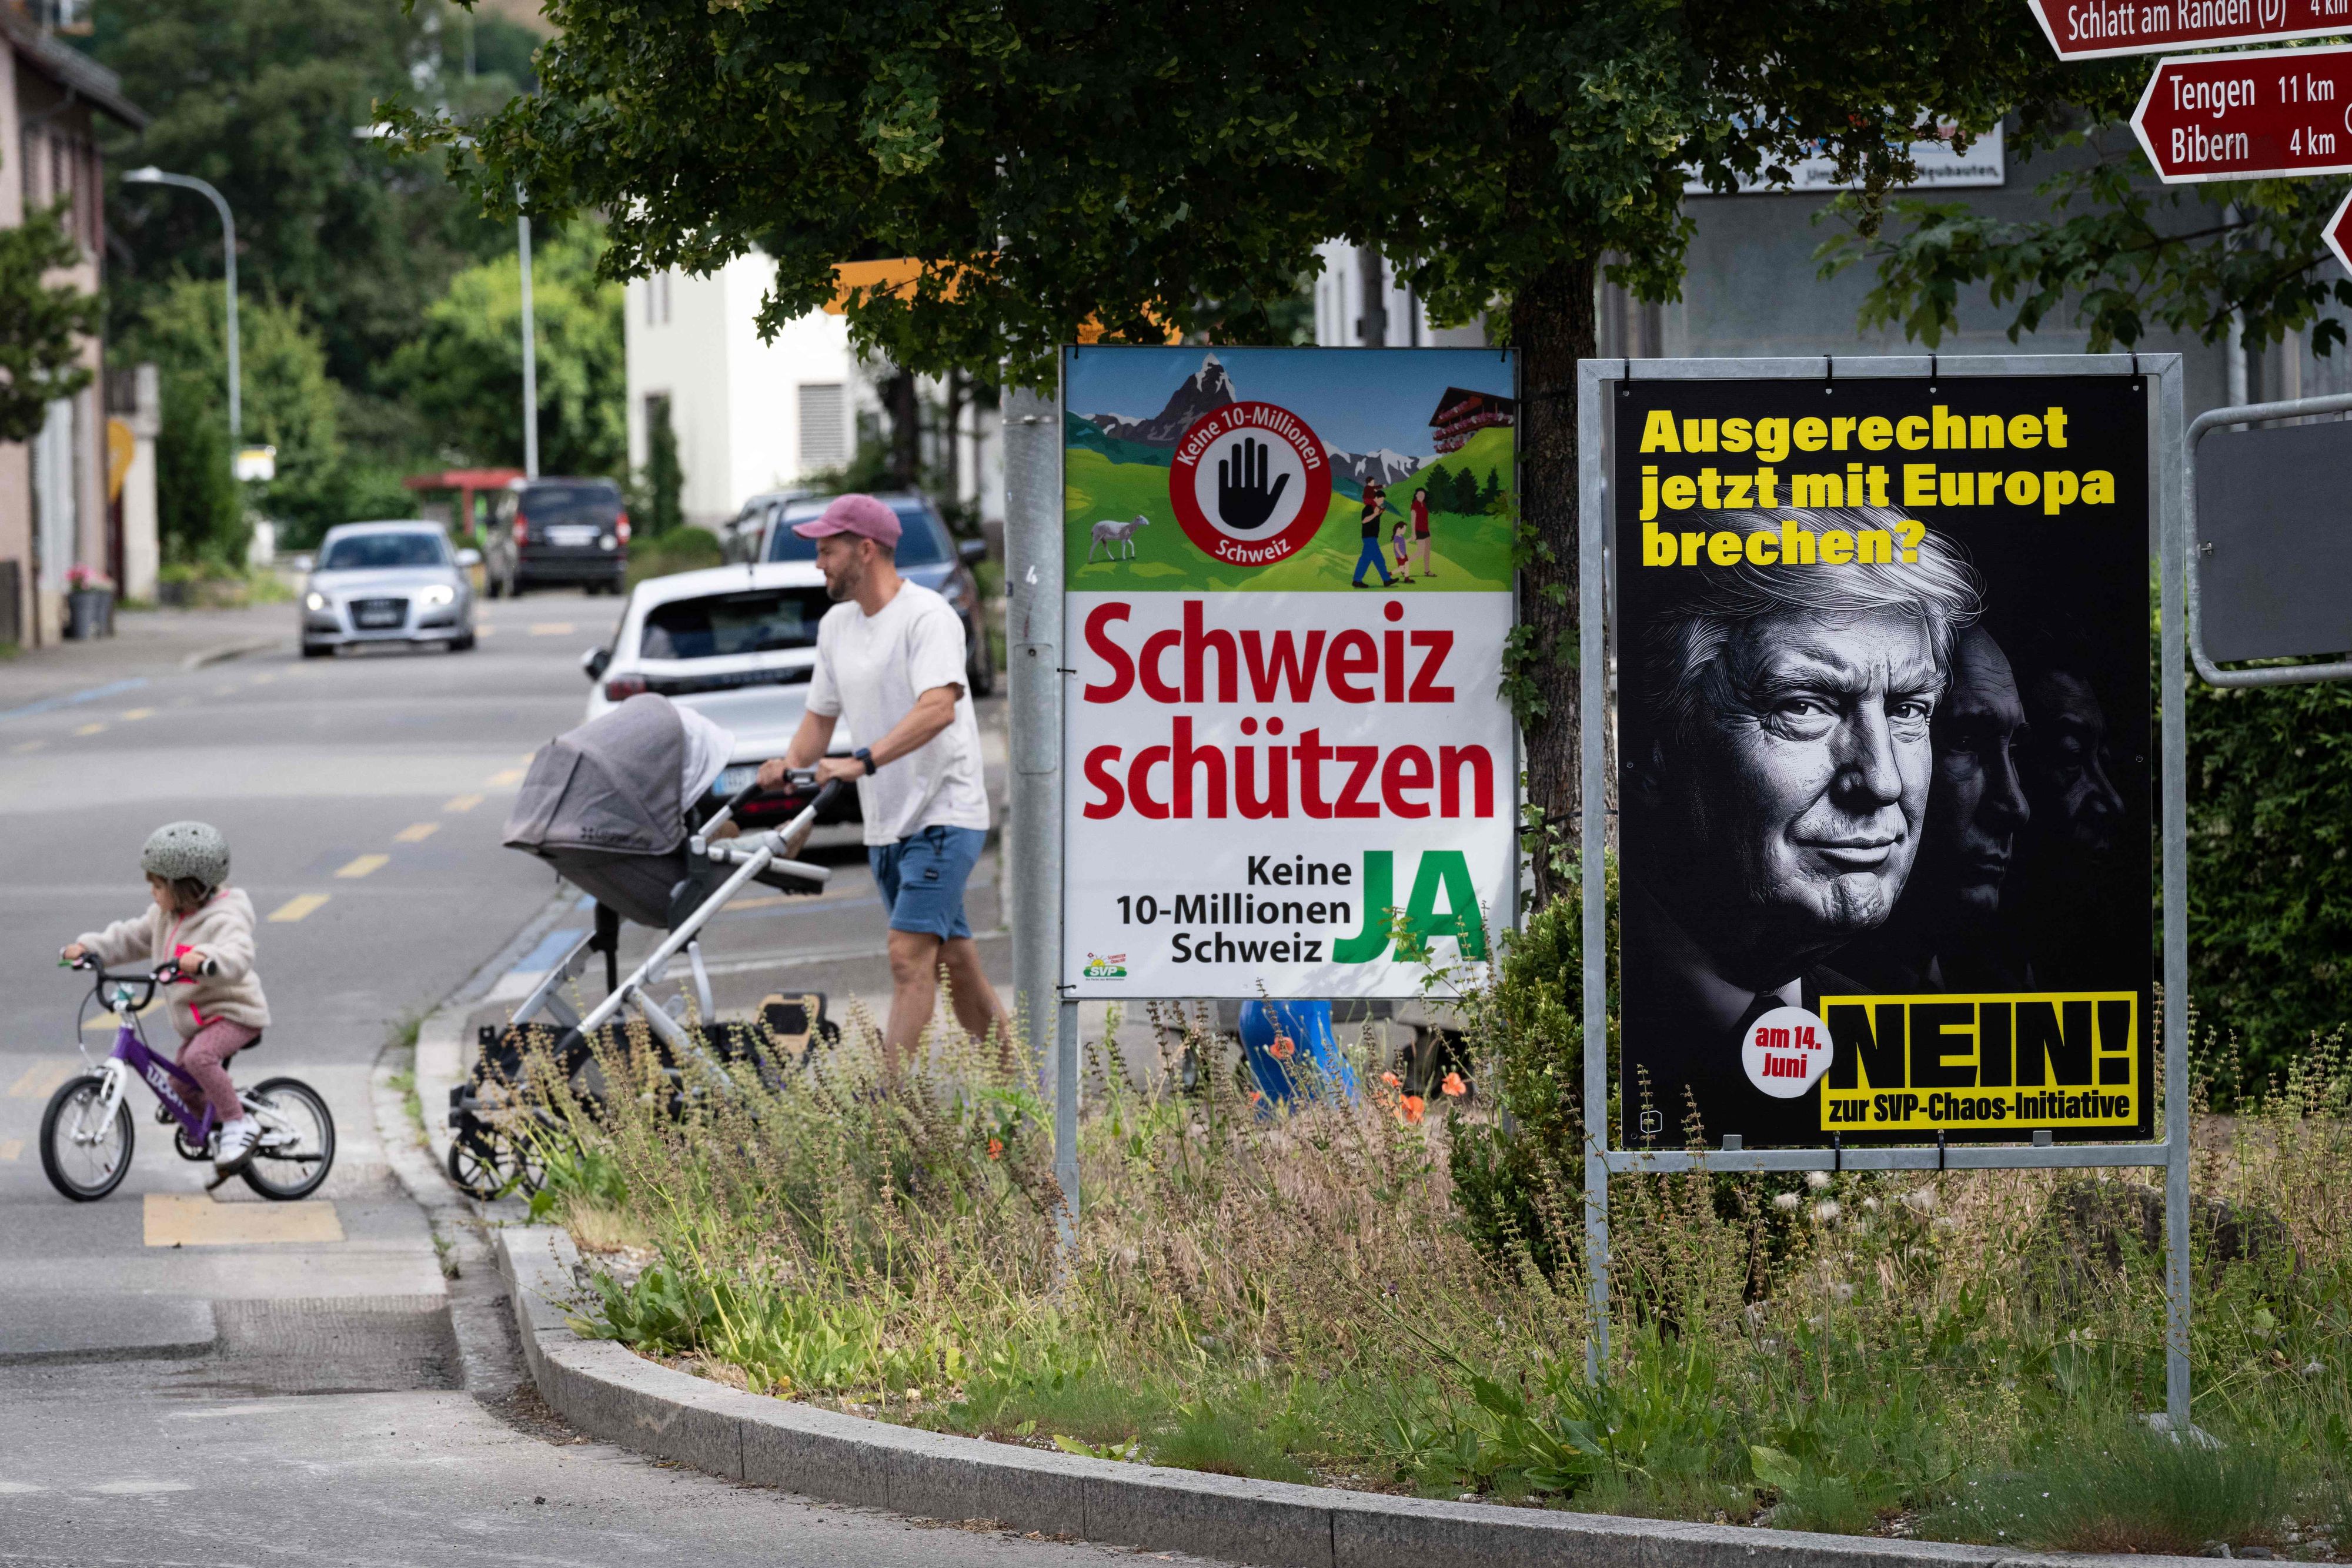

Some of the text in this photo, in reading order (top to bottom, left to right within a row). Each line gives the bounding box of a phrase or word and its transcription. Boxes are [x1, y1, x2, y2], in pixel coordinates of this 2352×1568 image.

[2068, 0, 2135, 40] Schlatt
[2141, 5, 2170, 34] am
[2178, 0, 2250, 29] Randen
[2258, 0, 2286, 29] (D)
[2170, 72, 2334, 118] Tengen 11 km
[2171, 124, 2336, 163] Bibern 4 km
[1177, 406, 1321, 470] Keine 10-Millionen
[1640, 405, 2067, 462] Ausgerechnet
[1639, 463, 2115, 521] jetzt mit Europa
[1215, 539, 1291, 563] Schweiz
[1642, 520, 1926, 567] brechen?
[1084, 600, 1455, 704] Schweiz
[1083, 716, 1494, 820] schützen
[1248, 855, 1352, 885] Keine
[1117, 894, 1350, 924] 10-Millionen
[1332, 850, 1486, 964] JA
[1171, 932, 1322, 963] Schweiz
[1090, 967, 1117, 976] SVP
[1755, 1026, 1822, 1049] am 14.
[1828, 1001, 2131, 1089] NEIN!
[1762, 1053, 1808, 1078] Juni
[1829, 1092, 2130, 1122] zur SVP-Chaos-Initiative
